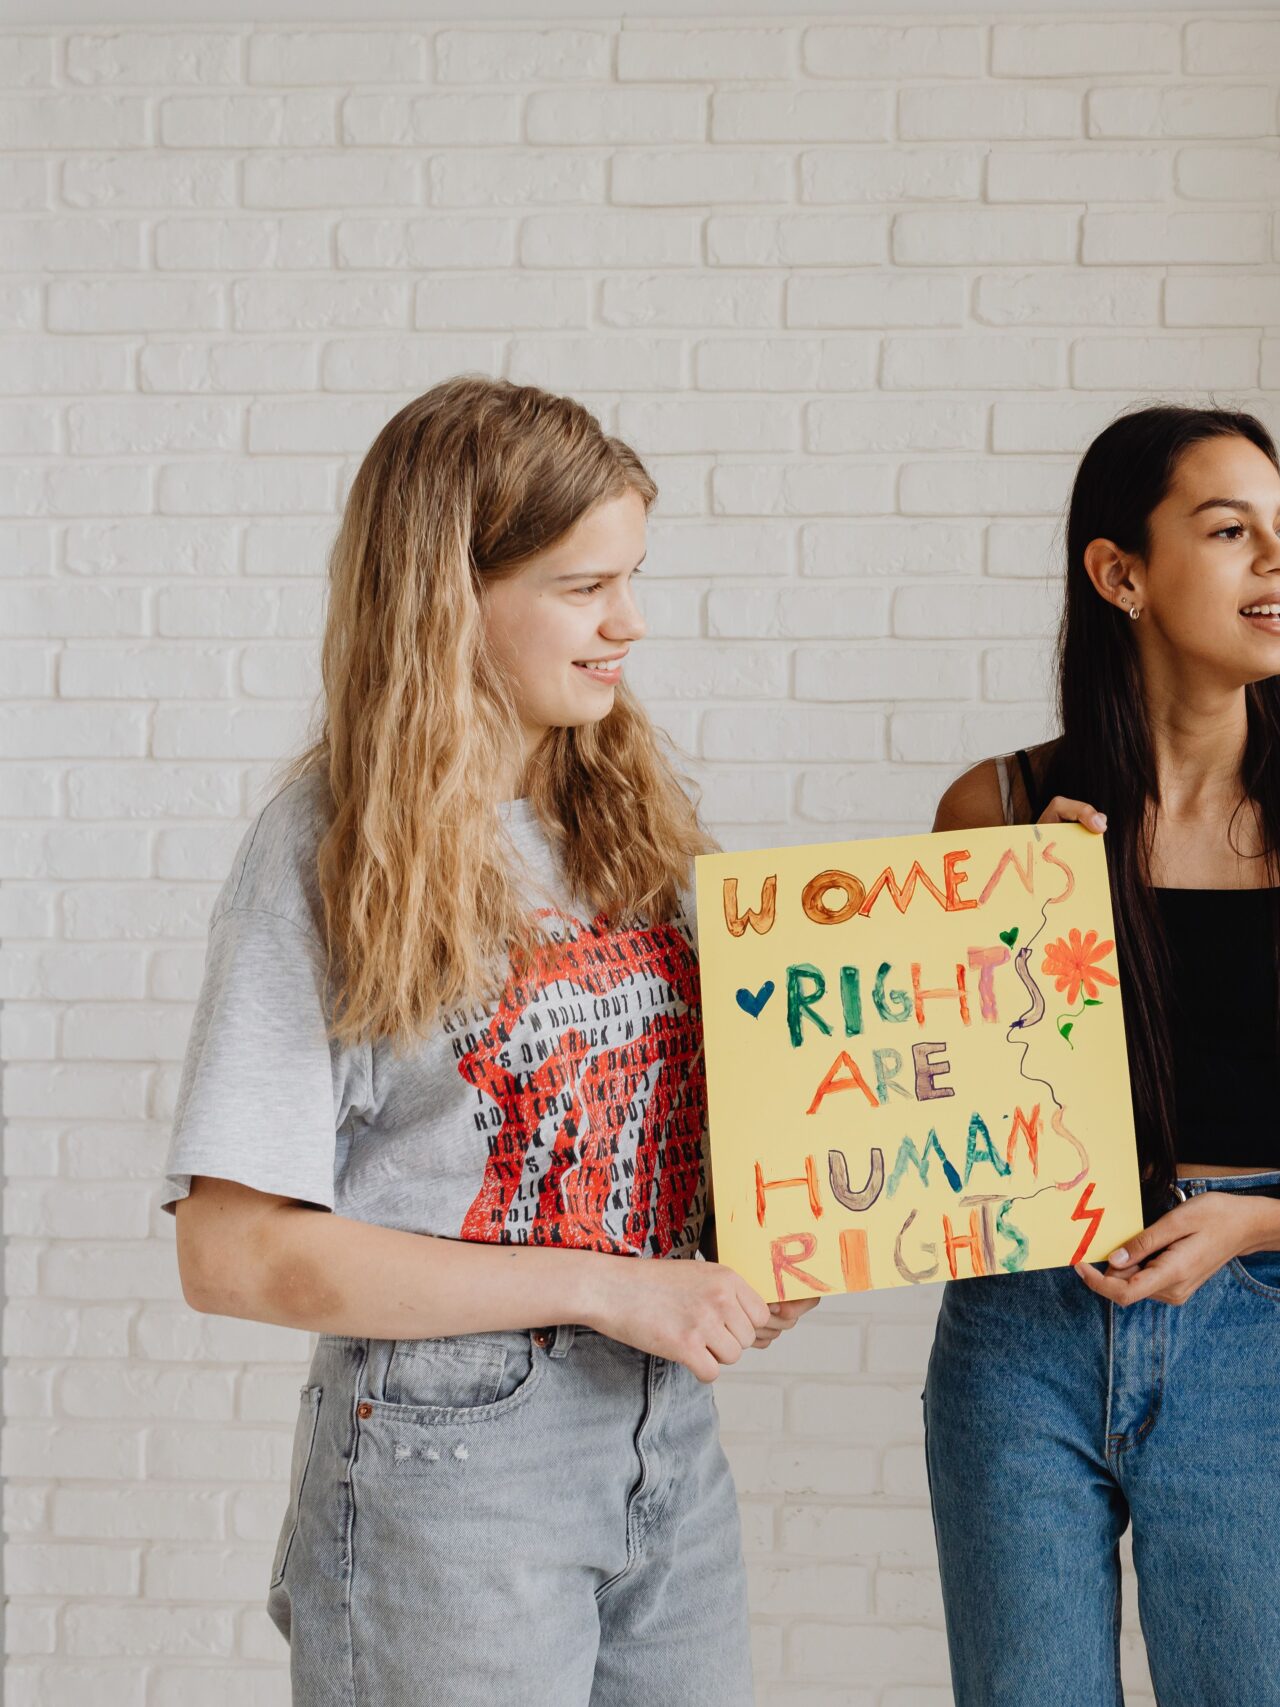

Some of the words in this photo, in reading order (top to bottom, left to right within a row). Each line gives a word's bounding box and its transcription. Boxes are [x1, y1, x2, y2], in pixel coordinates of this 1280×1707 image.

[555, 979, 563, 999] I
[568, 972, 608, 997] LIKE
[608, 965, 635, 989] IT)
[639, 955, 675, 981] IT'S
[629, 931, 675, 957] ROCK
[451, 1021, 512, 1059] ROCK
[547, 1002, 587, 1029] ROLL
[593, 993, 629, 1021] (BUT
[636, 990, 643, 1010] I
[648, 979, 686, 1007] LIKE
[785, 946, 1046, 1048] RIGHTS
[466, 1051, 512, 1084] IT'S
[520, 1034, 566, 1064] ONLY
[568, 1025, 609, 1054] ROCK
[641, 1007, 682, 1037] ROLL
[477, 1088, 484, 1105] I
[490, 1070, 539, 1098] LIKE
[607, 1043, 649, 1073] ONLY
[657, 1031, 699, 1061] ROCK
[806, 1042, 956, 1116] ARE
[473, 1101, 526, 1132] ROLL
[623, 1070, 650, 1096] IT)
[657, 1061, 689, 1089] IT'S
[486, 1127, 545, 1157] ROCK
[605, 1098, 648, 1129] (BUT
[491, 1155, 540, 1181] IT'S
[652, 1115, 694, 1143] ROLL
[499, 1186, 505, 1205] I
[517, 1171, 559, 1203] LIKE
[657, 1141, 705, 1170] ROCK
[490, 1201, 546, 1224] ROLL
[669, 1165, 706, 1194] IT'S
[499, 1222, 563, 1246] ROCK
[769, 1193, 1030, 1302] RIGHTS
